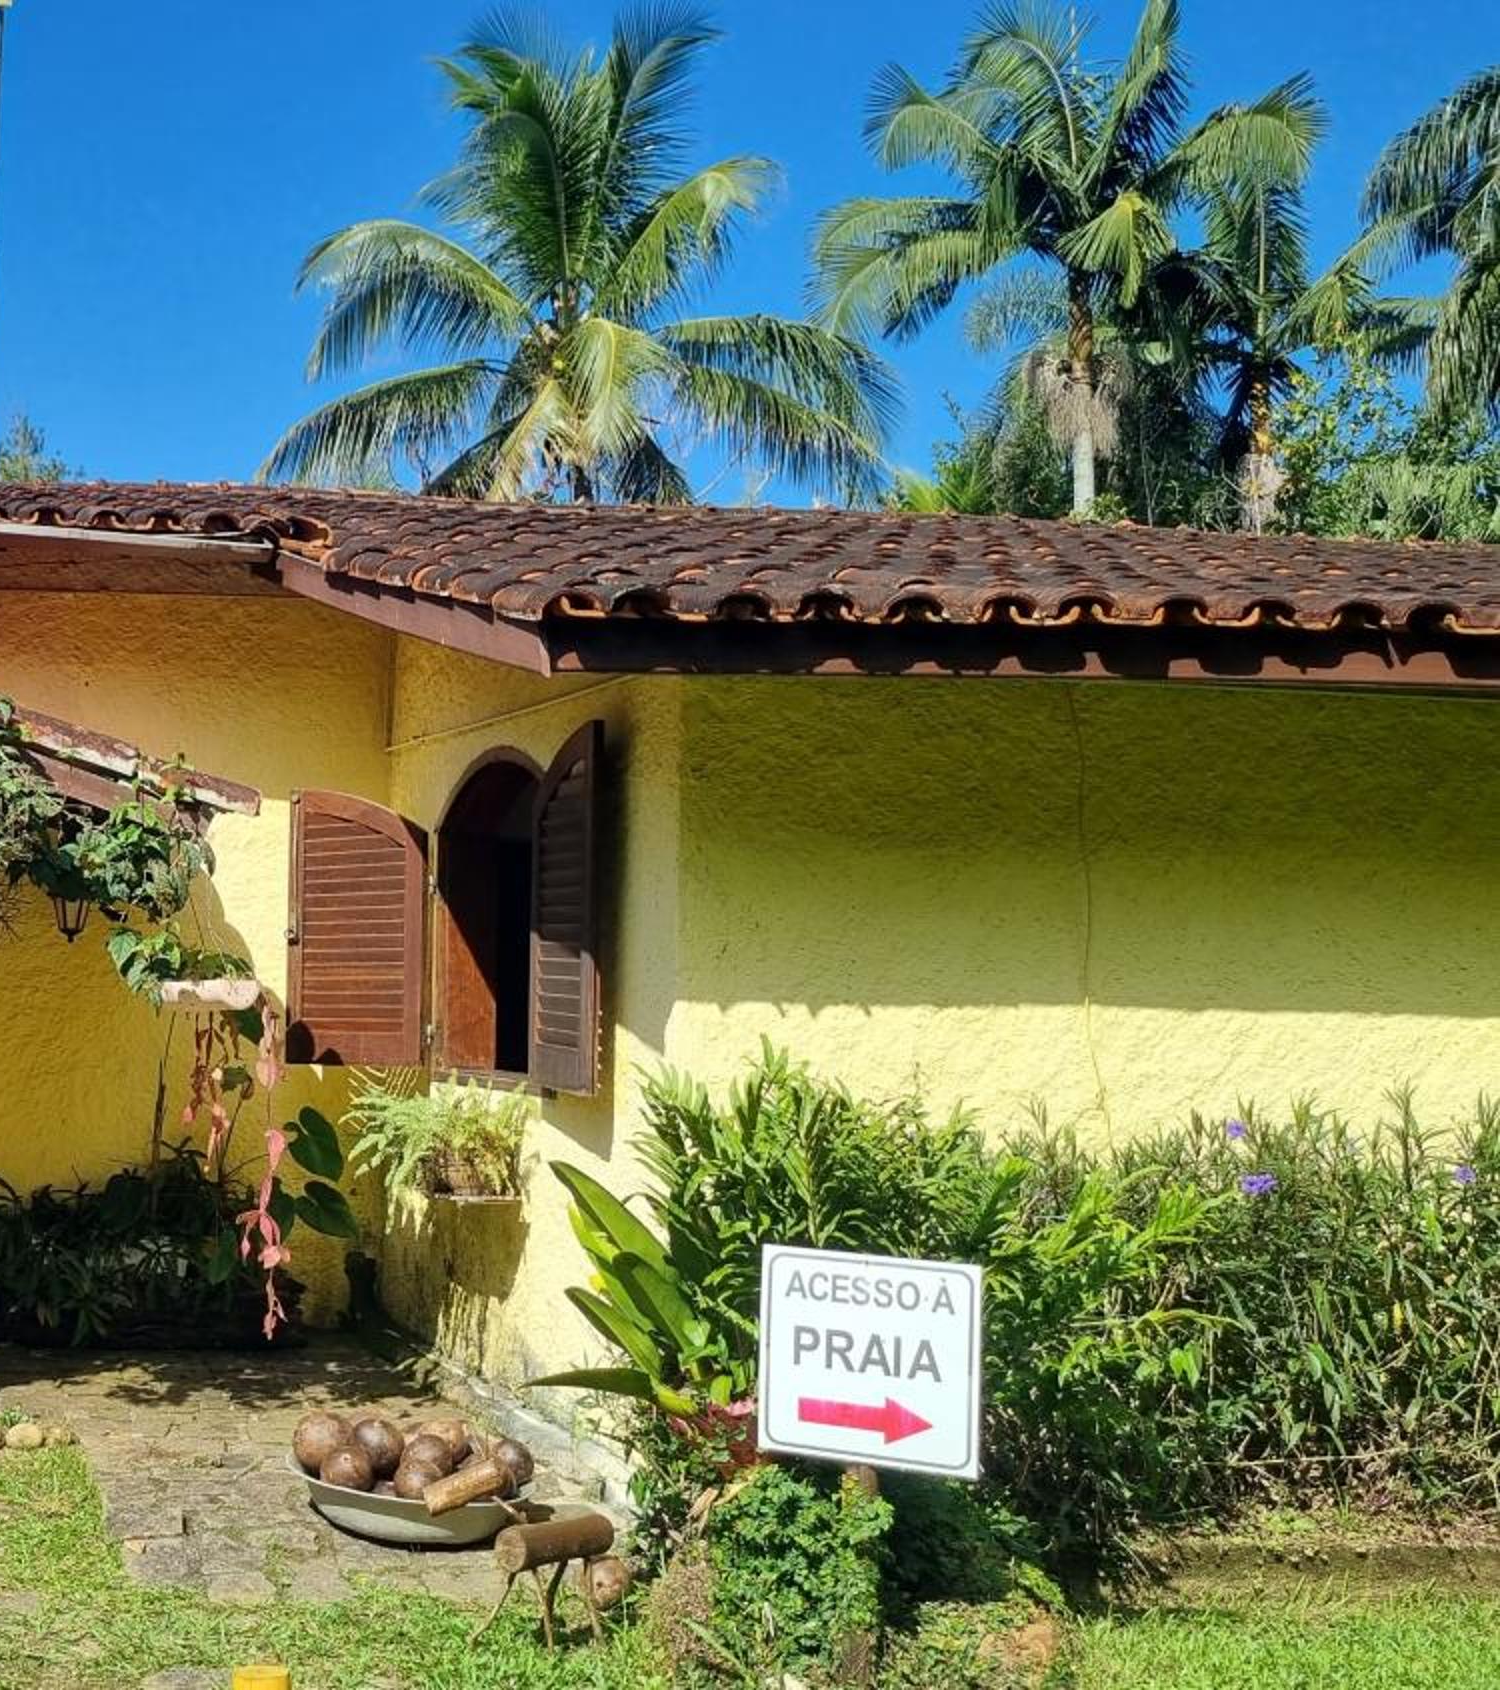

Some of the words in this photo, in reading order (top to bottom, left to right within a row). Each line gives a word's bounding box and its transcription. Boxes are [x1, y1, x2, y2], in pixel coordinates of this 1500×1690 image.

[785, 1269, 921, 1311] ACESSO
[931, 1277, 956, 1316] À
[792, 1325, 943, 1383] PRAIA
